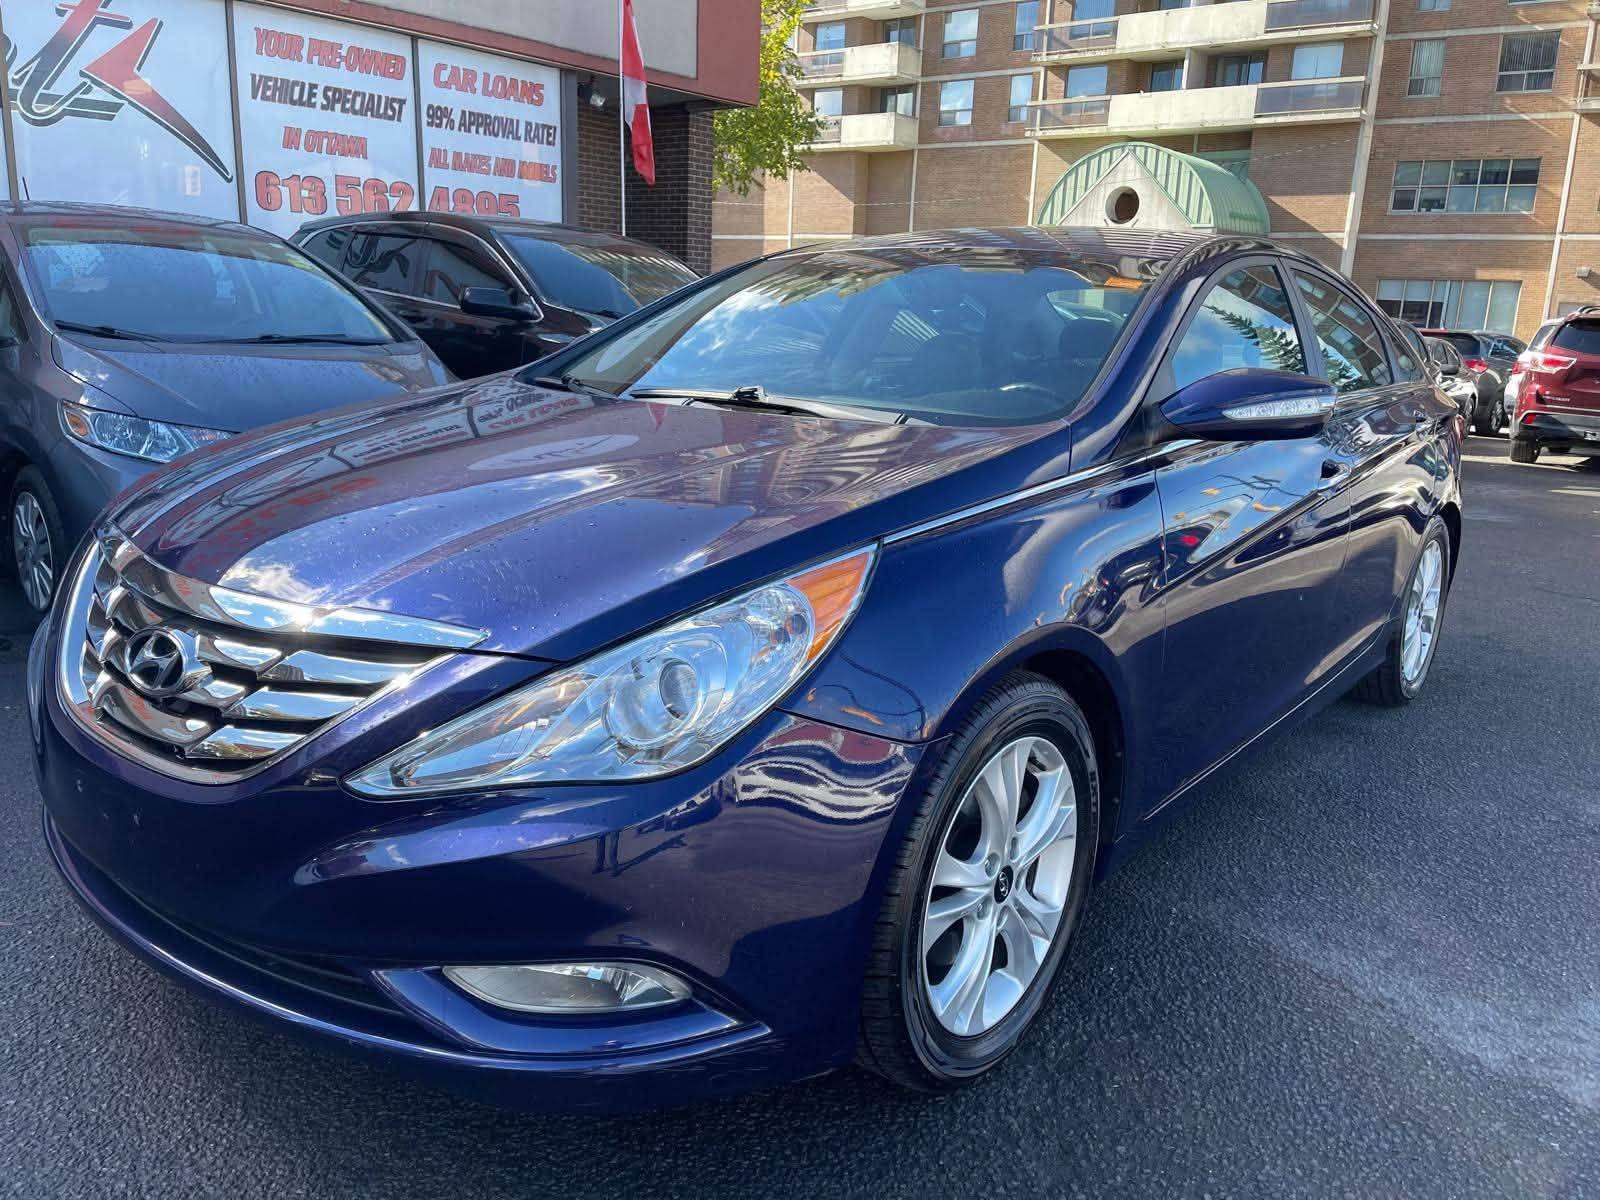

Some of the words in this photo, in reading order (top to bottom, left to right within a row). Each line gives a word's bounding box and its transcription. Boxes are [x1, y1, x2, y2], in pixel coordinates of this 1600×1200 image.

[254, 27, 304, 62] YOUR
[307, 37, 407, 80] PRE-OWNED
[250, 73, 318, 108] VEHICLE
[320, 85, 407, 122] SPECIALIST
[433, 63, 477, 94] CAR
[482, 72, 544, 106] LOANS
[282, 126, 302, 150] IN
[304, 130, 368, 159] OTTAWA
[426, 104, 455, 130] 99%
[458, 110, 522, 141] APPROVAL
[524, 120, 557, 147] RATE!
[428, 147, 449, 170] ALL
[451, 151, 491, 176] MAKES
[493, 157, 516, 178] AND
[255, 171, 328, 215] 613
[334, 174, 414, 217] 562
